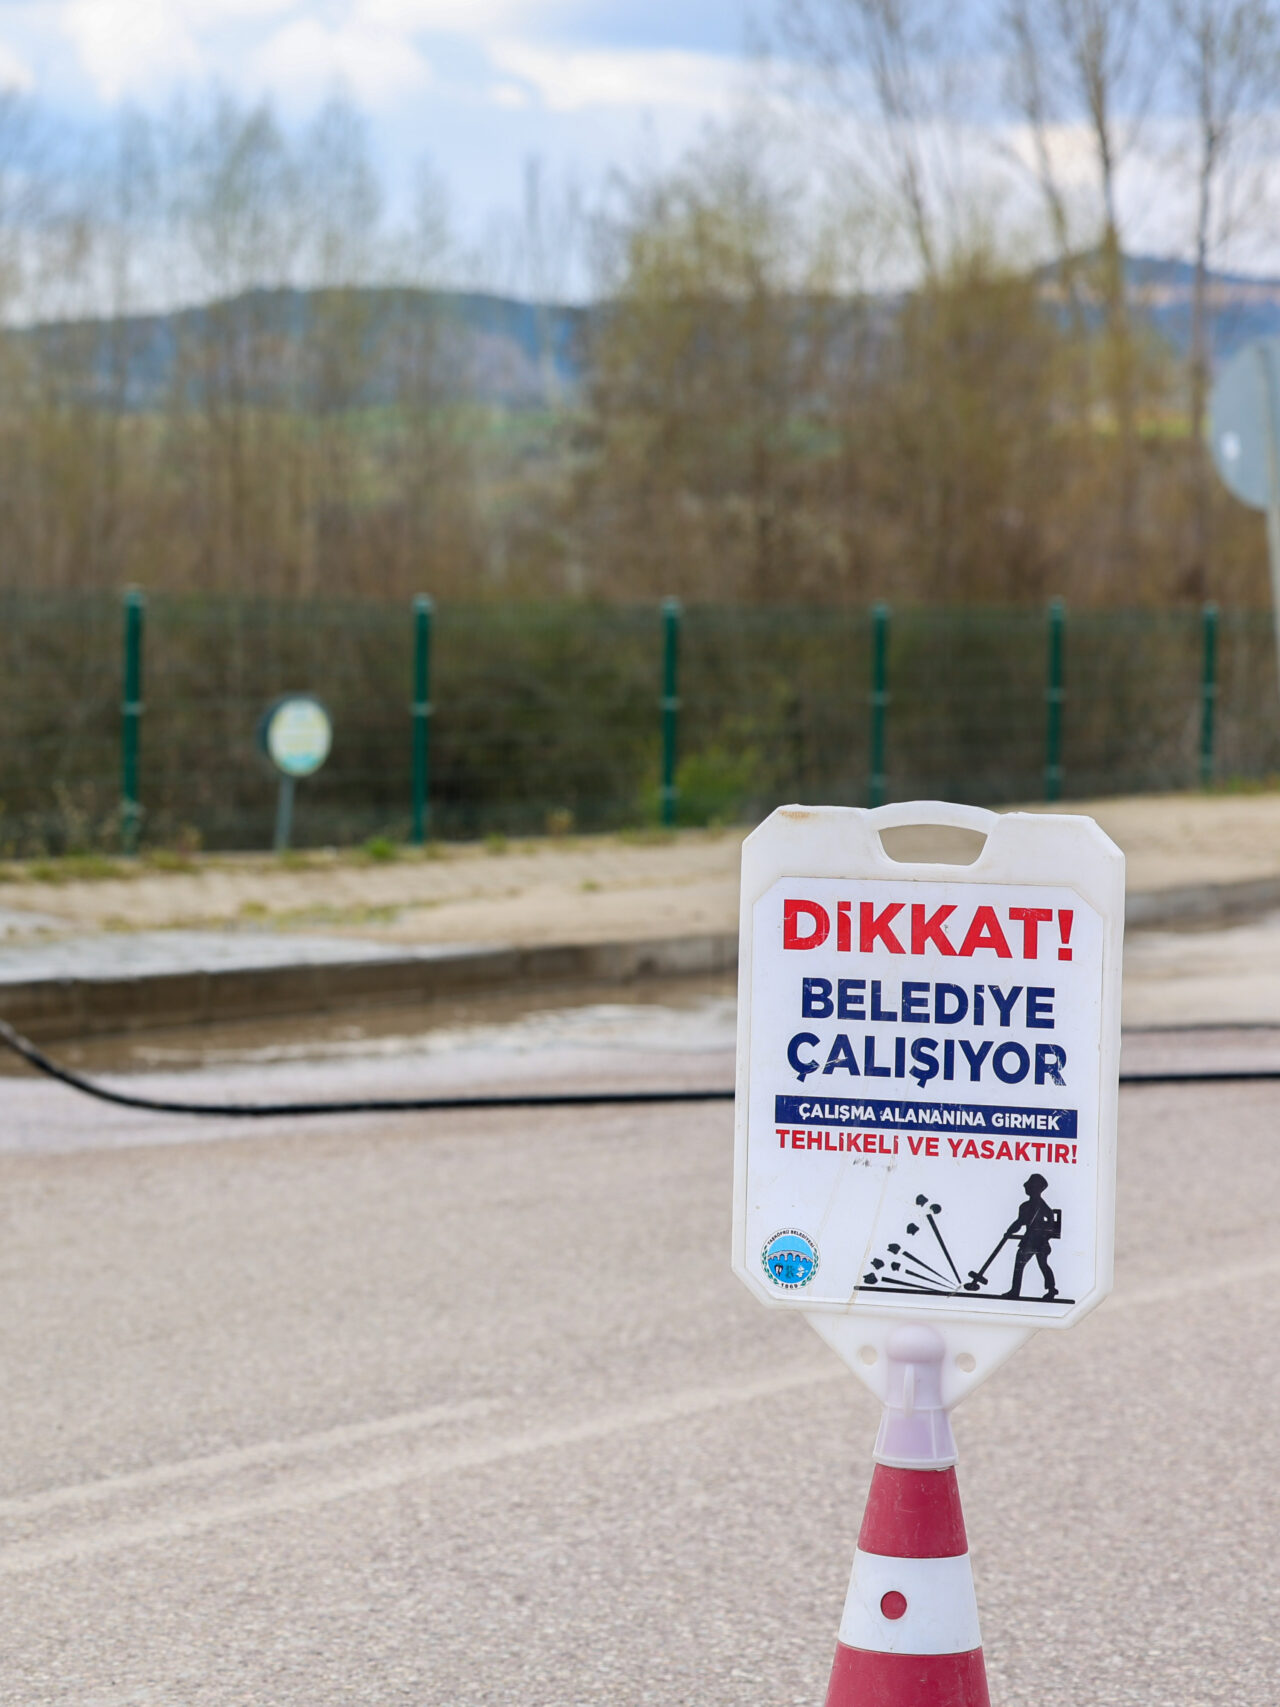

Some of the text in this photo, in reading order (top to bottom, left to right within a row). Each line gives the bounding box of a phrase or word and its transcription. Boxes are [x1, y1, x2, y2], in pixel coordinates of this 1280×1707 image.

[782, 898, 1075, 962] DİKKAT!
[801, 976, 1056, 1030] BELEDİYE
[786, 1032, 1068, 1089] ÇALIŞIYOR
[798, 1102, 1061, 1131] ÇALIŞMA ALANANINA GİRMEK
[775, 1128, 1078, 1164] TEHLİKELİ VE YASAKTIR!
